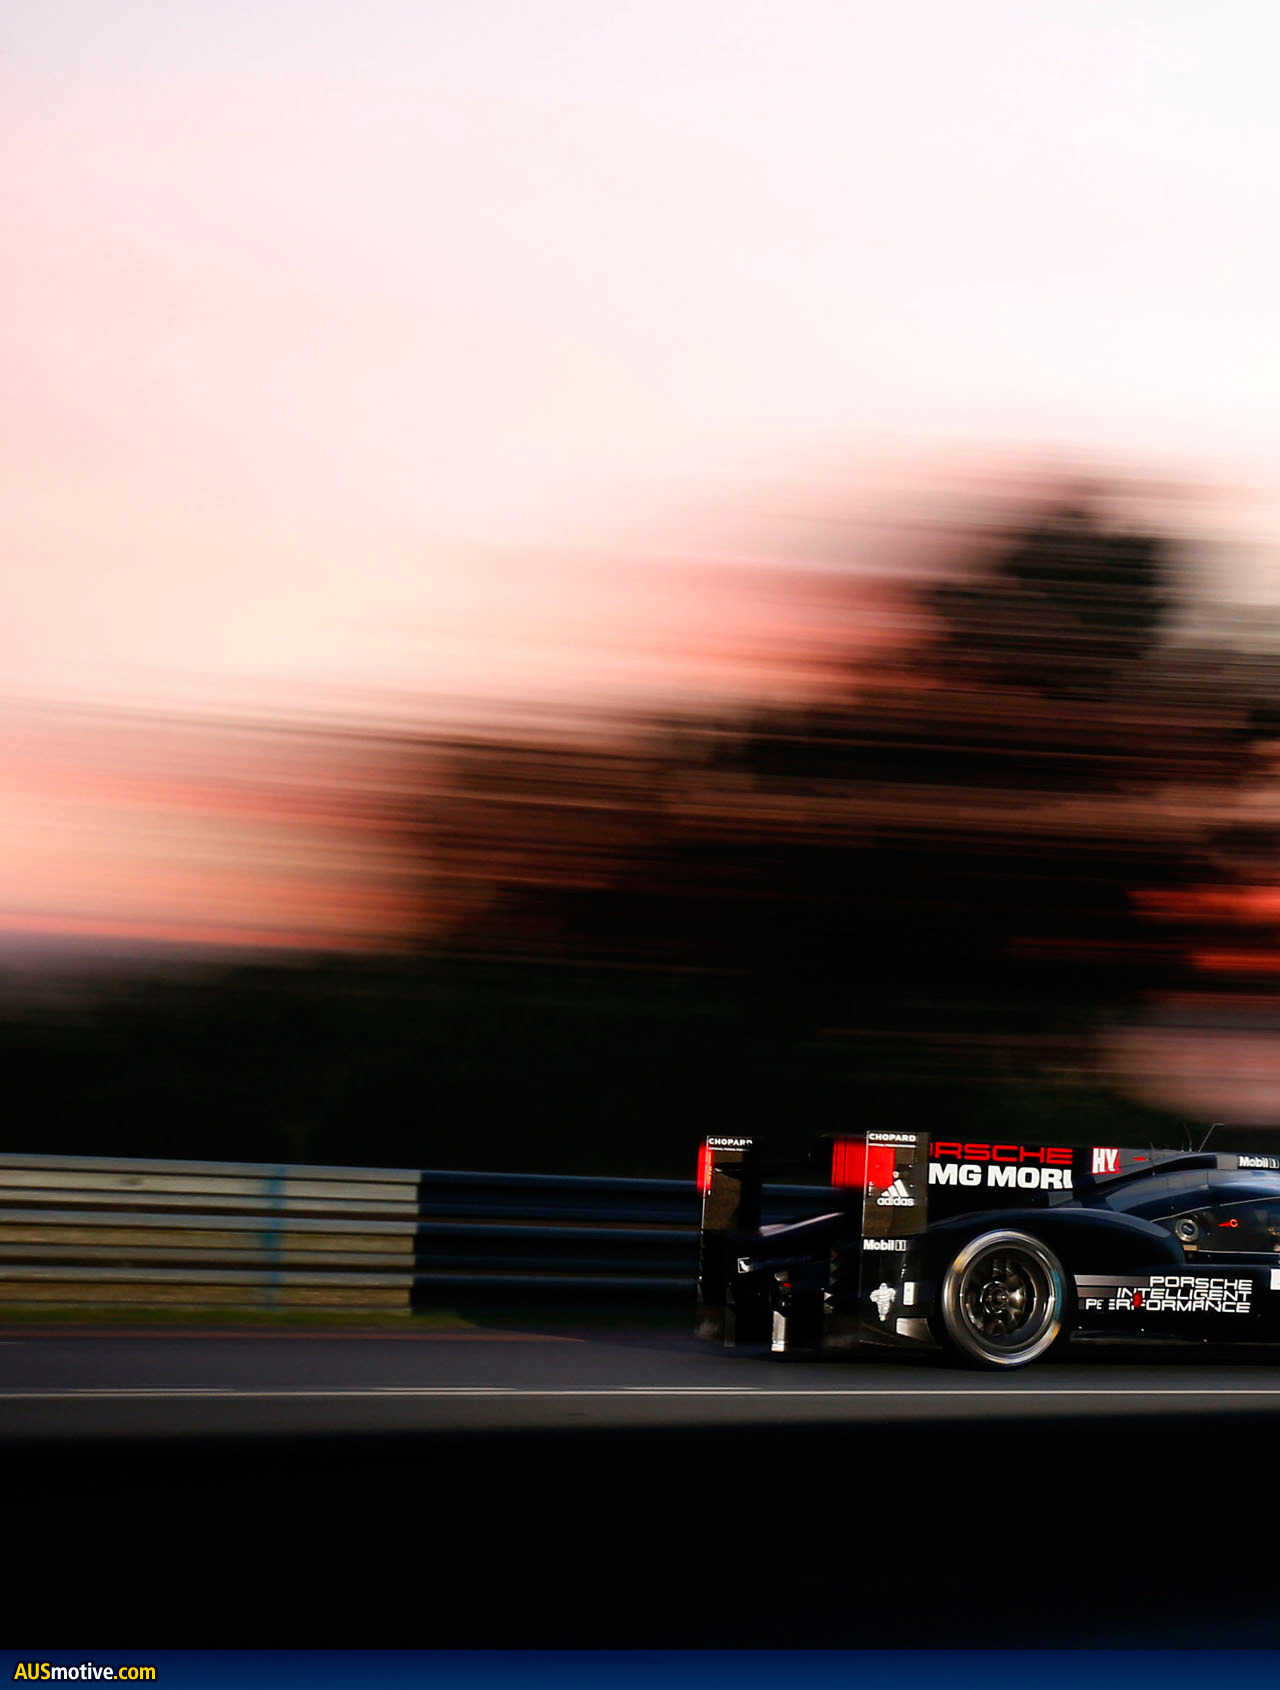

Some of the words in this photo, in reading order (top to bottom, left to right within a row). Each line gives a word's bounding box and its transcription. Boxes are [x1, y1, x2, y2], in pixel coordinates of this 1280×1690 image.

[869, 1133, 916, 1142] CHOPARD
[929, 1142, 1073, 1165] RSCHE
[1092, 1148, 1118, 1173] HY
[1239, 1156, 1269, 1168] Mobil
[877, 1197, 915, 1206] adidas
[863, 1239, 895, 1251] Mobil
[1150, 1276, 1253, 1290] PORSCHE
[1117, 1288, 1252, 1301] INTELLIGENT
